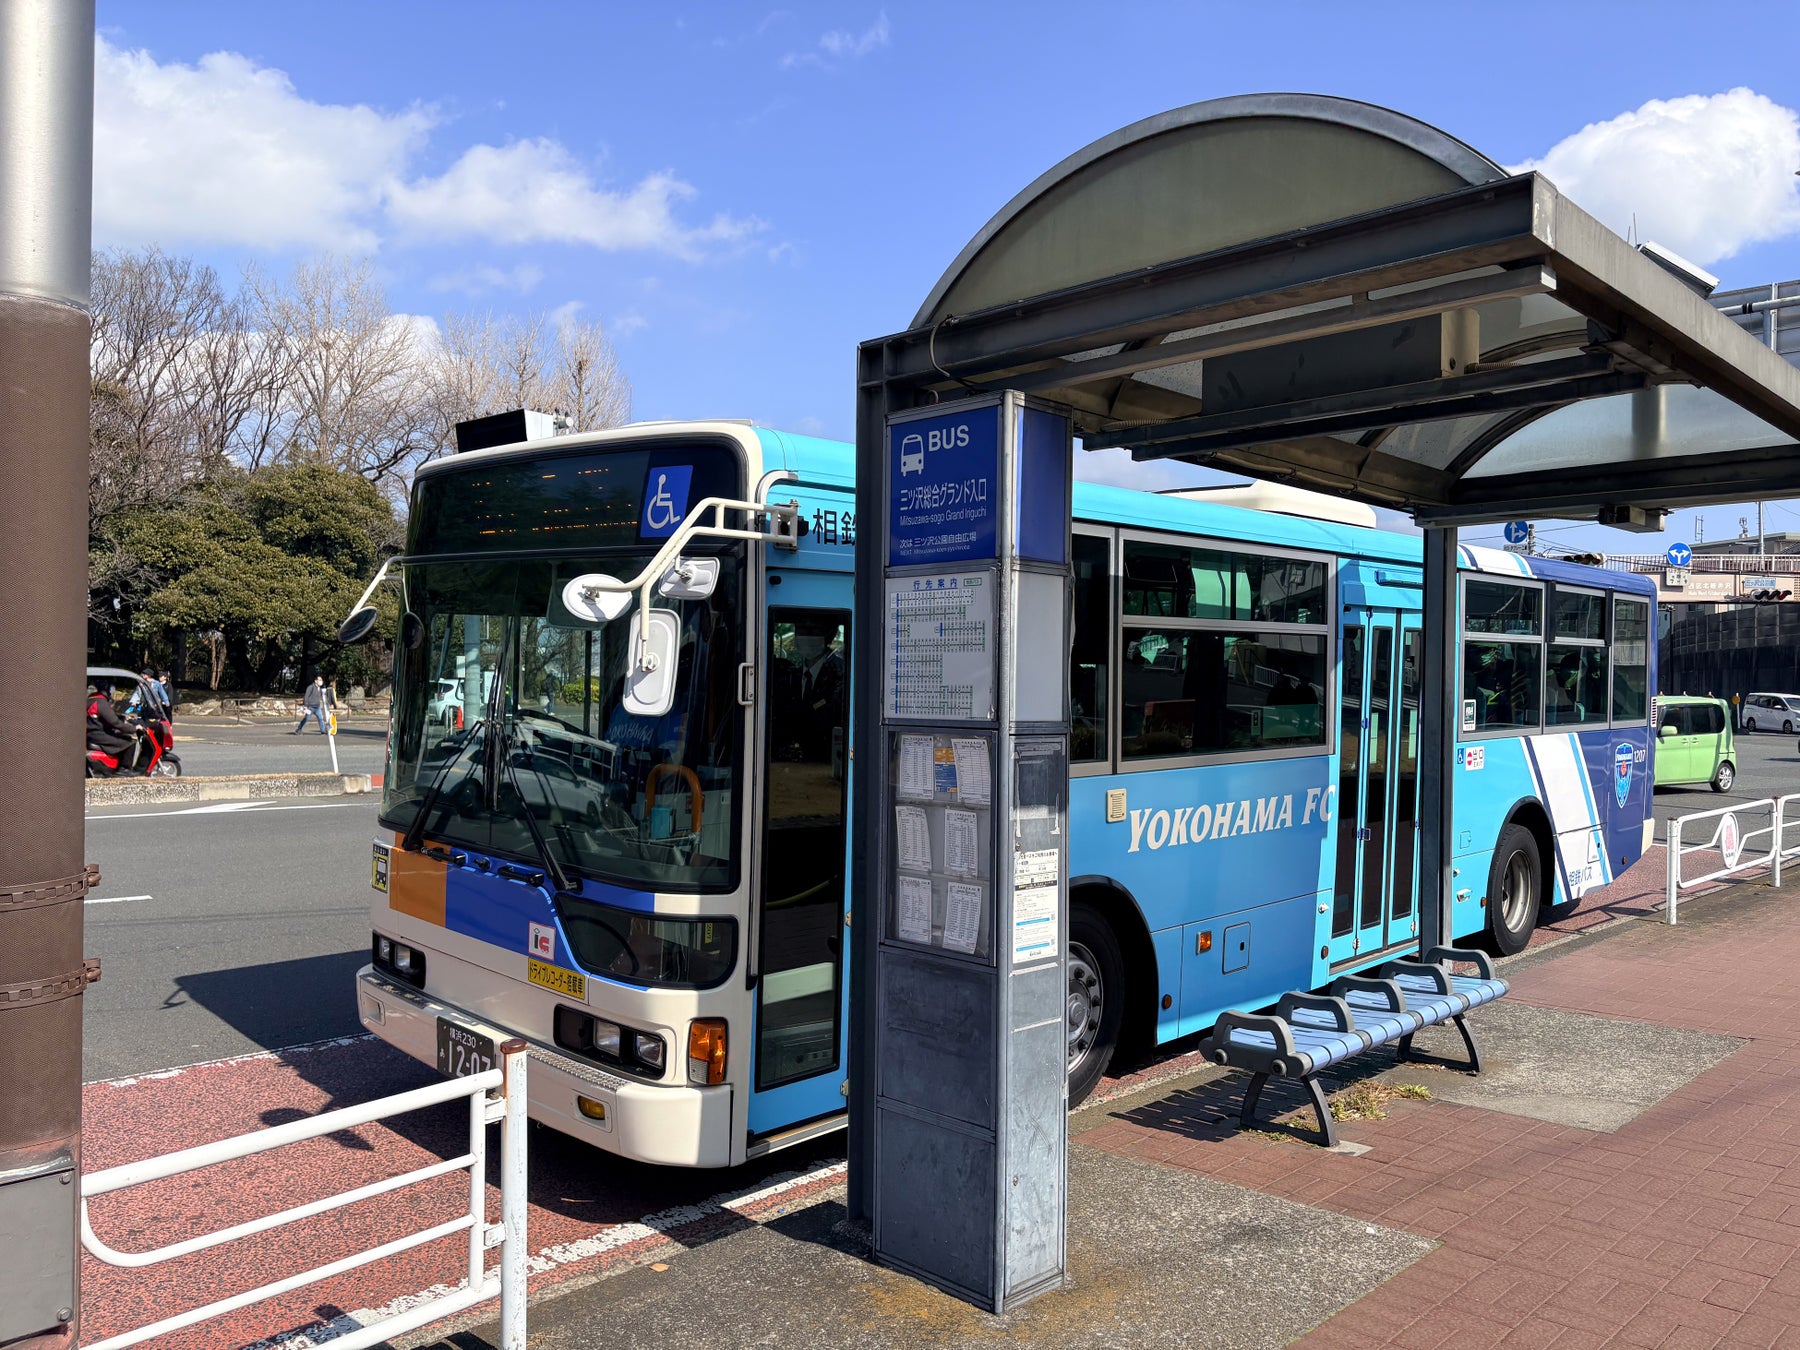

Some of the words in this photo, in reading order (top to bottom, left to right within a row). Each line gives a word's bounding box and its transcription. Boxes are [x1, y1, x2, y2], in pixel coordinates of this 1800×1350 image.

[928, 424, 970, 452] BUS
[899, 478, 987, 511] 三ツ沢総合グランド入口
[945, 507, 965, 521] Grand
[1634, 749, 1646, 763] 1207
[1127, 794, 1293, 853] YOKOHAMA
[1301, 784, 1336, 825] FC
[1568, 866, 1593, 887] 相鉄バス
